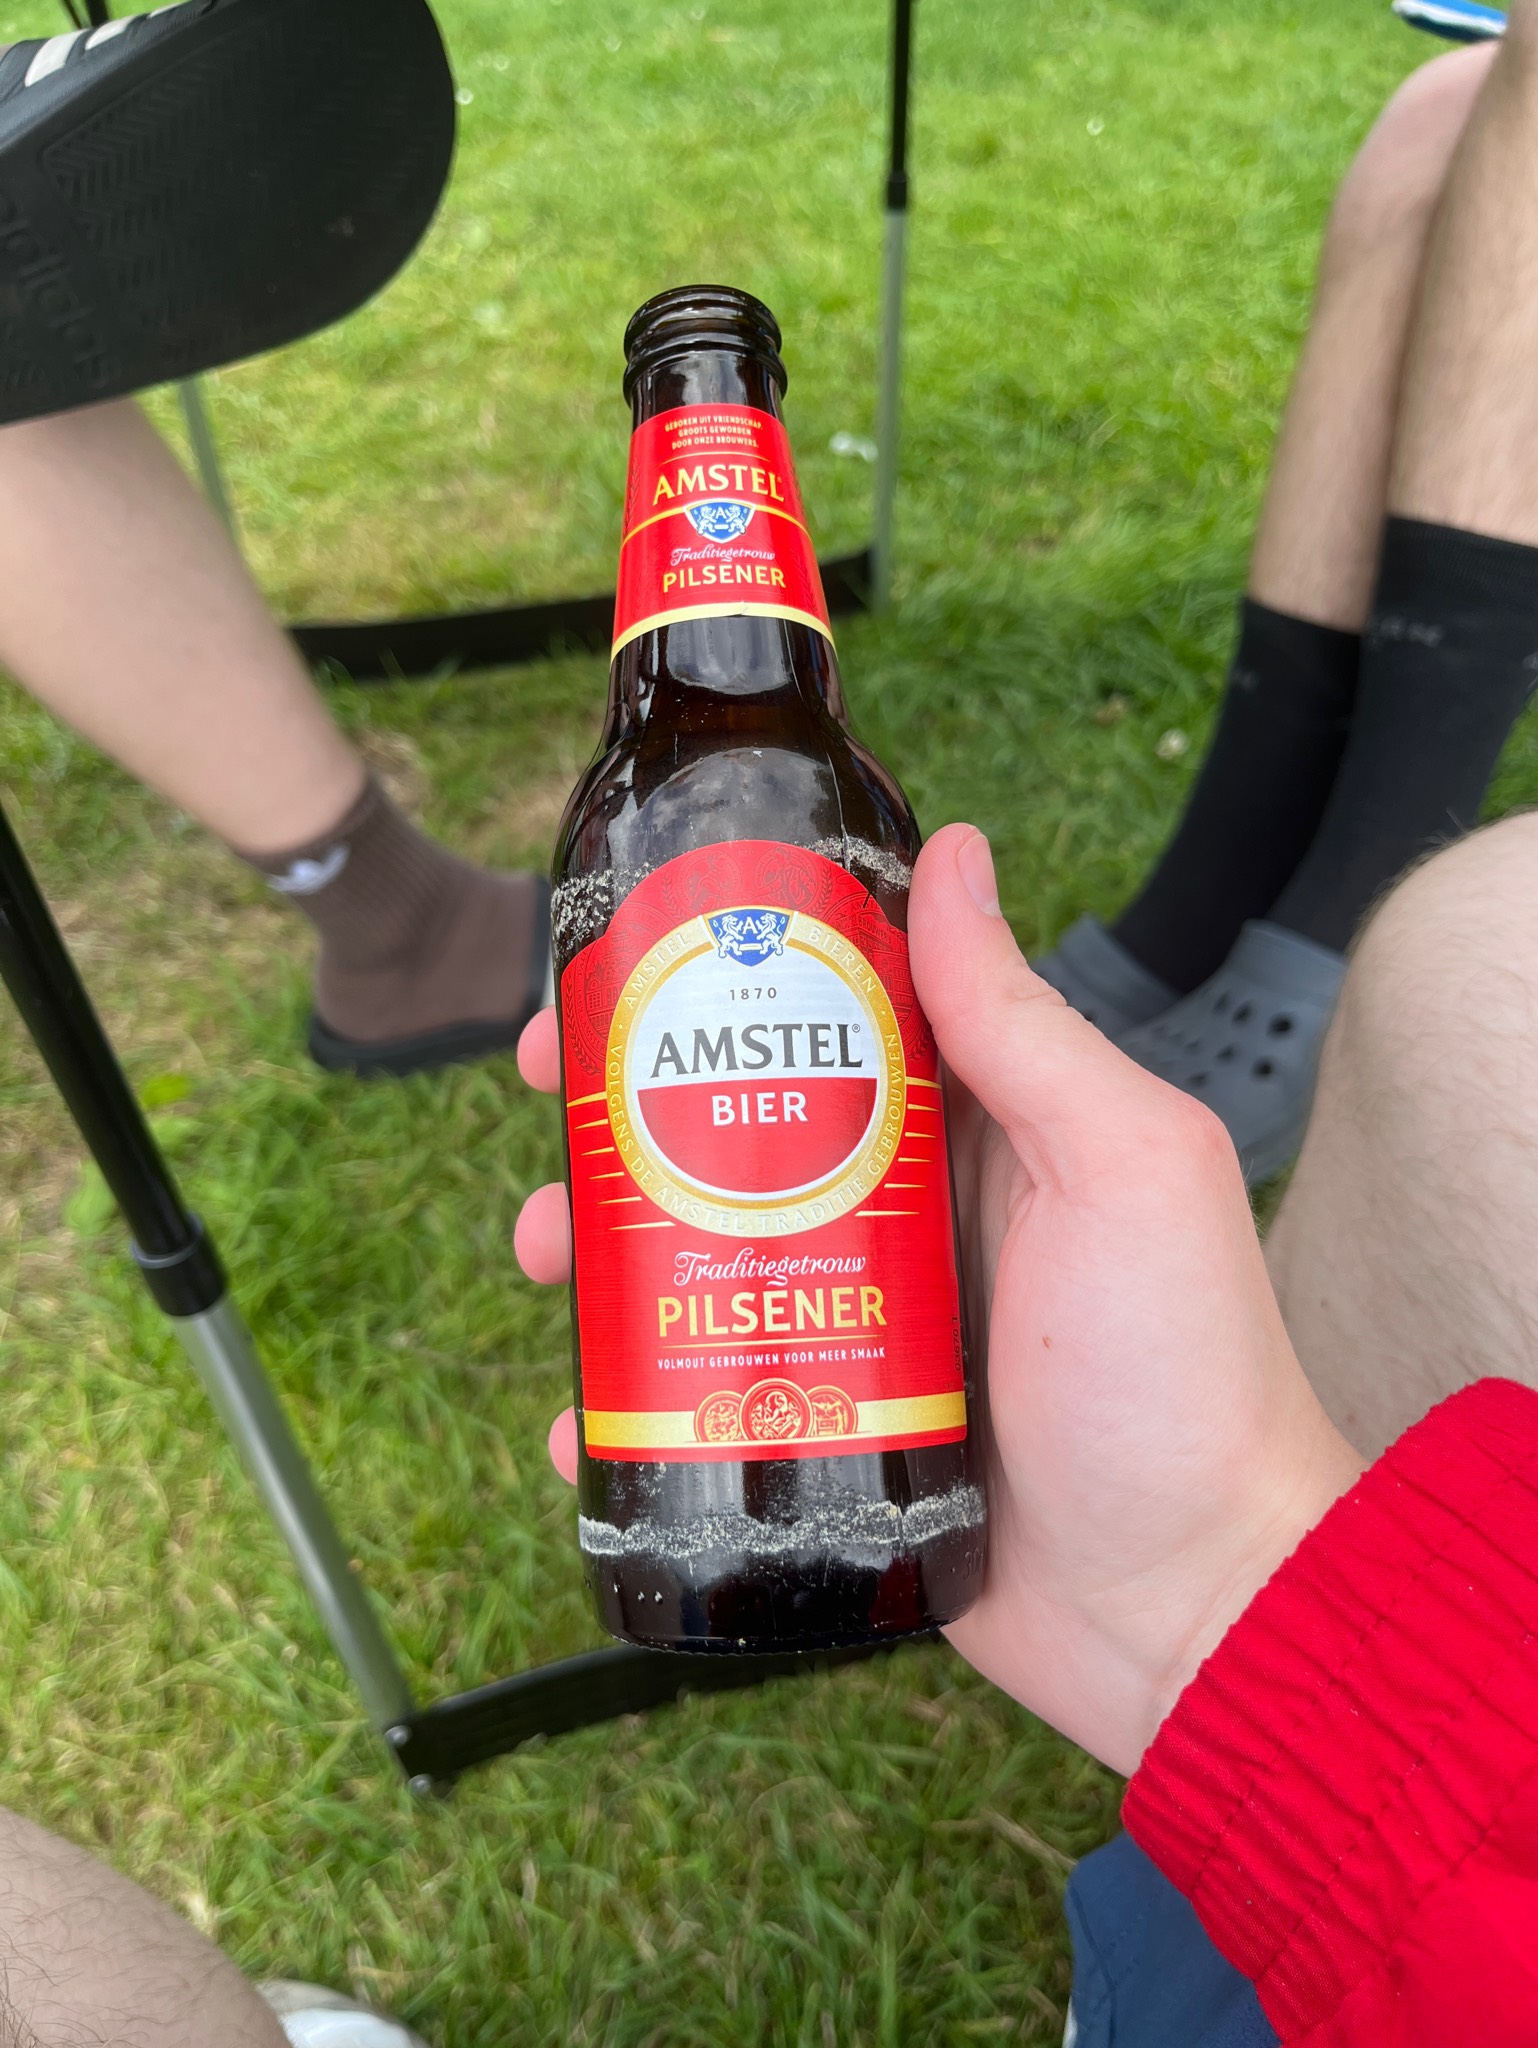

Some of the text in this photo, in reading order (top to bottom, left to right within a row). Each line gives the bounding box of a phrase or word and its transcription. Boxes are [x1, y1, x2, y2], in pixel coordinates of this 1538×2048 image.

[665, 415, 763, 432] GEBOREN UIT VRIENDSCHAP.
[678, 425, 751, 437] GROOTS GEWORDEN
[672, 436, 759, 450] DOOR ONZE BROUWERS.
[652, 464, 785, 507] AMSTEL
[670, 543, 776, 567] Traditiegetrouw
[663, 564, 786, 593] PILSENER
[624, 925, 876, 1009] AMSTEL BIEREN
[729, 987, 777, 1001] 1870
[650, 1023, 863, 1079] AMSTEL
[712, 1091, 808, 1126] BIER
[608, 1033, 903, 1233] VOLGENS DE AMSTEL TRADITIE GEBROUWEN
[673, 1247, 866, 1286] Traditiegetrouw
[658, 1286, 888, 1338] PILSENER
[658, 1346, 885, 1370] VOLMOUT GEBROUWEN VOOR MEER SMAAK
